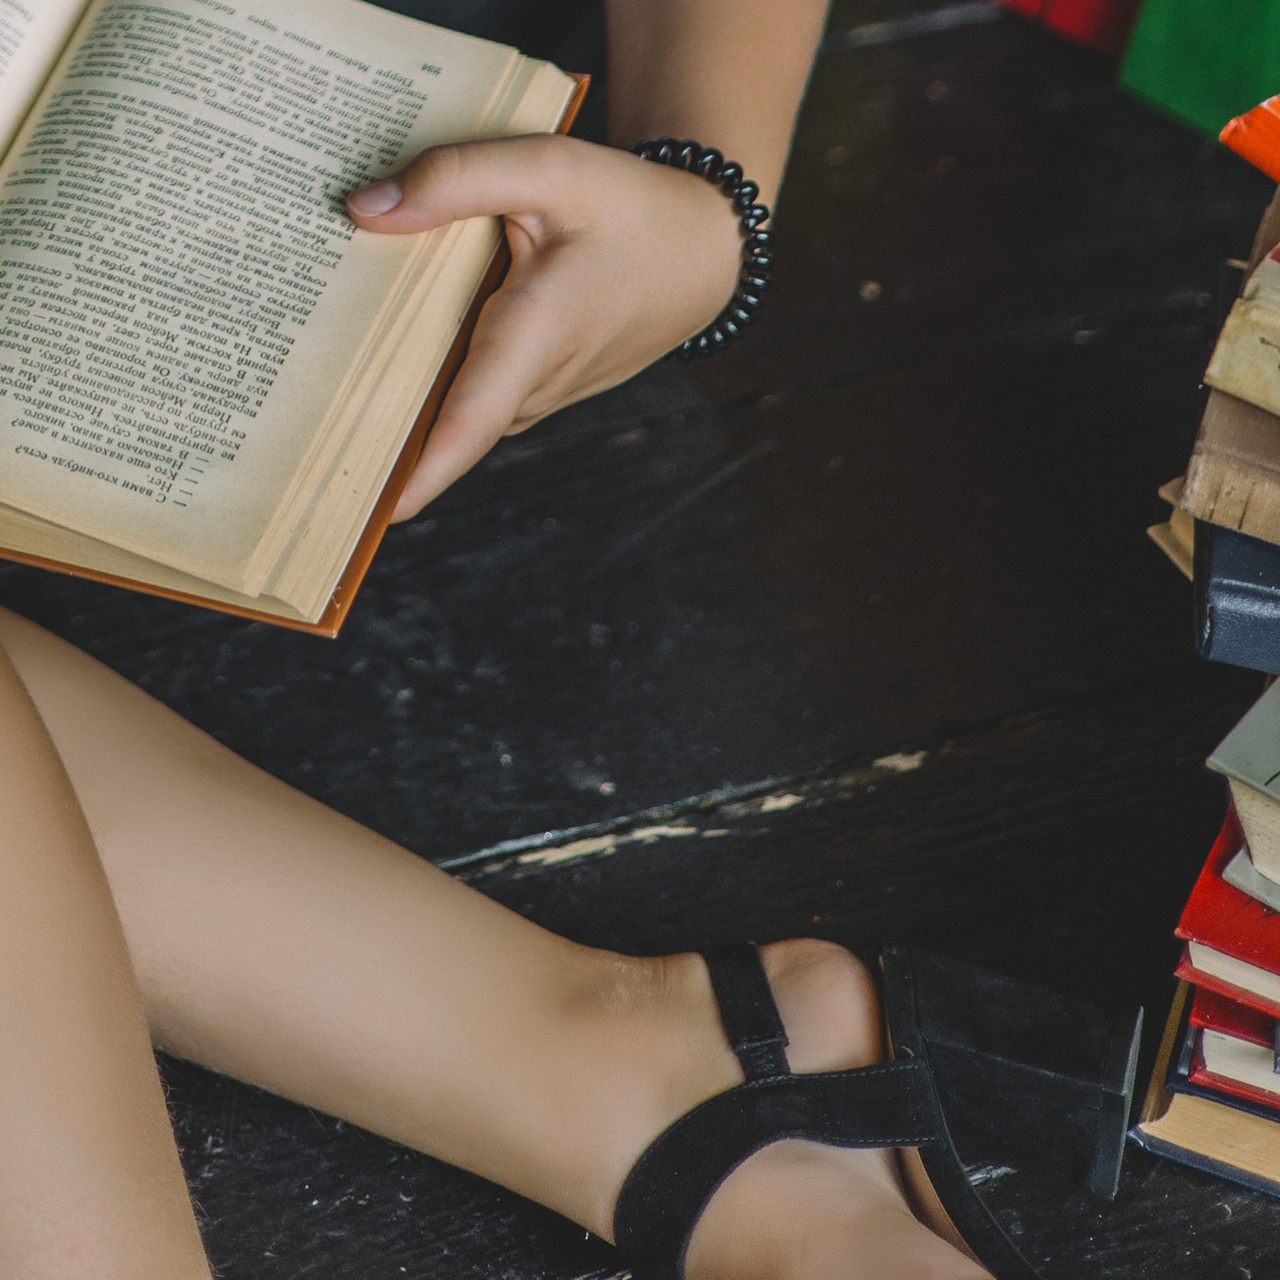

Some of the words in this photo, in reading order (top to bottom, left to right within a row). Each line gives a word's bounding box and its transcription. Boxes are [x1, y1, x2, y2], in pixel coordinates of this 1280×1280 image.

[27, 285, 80, 306] комнату
[73, 274, 125, 297] помазок
[6, 305, 32, 317] она
[38, 301, 88, 321] постели
[80, 300, 130, 323] пересек
[136, 294, 183, 319] бритья
[144, 309, 170, 325] над
[46, 315, 101, 338] комнаты
[89, 317, 108, 328] на
[182, 310, 208, 325] для
[208, 319, 243, 337] крем
[64, 333, 81, 344] ее
[129, 319, 179, 343] Мейсон
[177, 322, 229, 345] полочке
[28, 333, 83, 359] обратно
[82, 337, 149, 367] торопливо
[103, 332, 143, 352] конце
[143, 334, 181, 354] горел
[229, 341, 253, 356] На
[83, 350, 148, 379] портсигар
[143, 347, 191, 369] заднем
[181, 349, 233, 372] спальне
[233, 353, 281, 378] черний
[85, 365, 136, 388] повесил
[149, 363, 172, 378] Он
[204, 368, 243, 388] дверь
[36, 387, 54, 398] не
[149, 373, 189, 393] сунул
[244, 382, 270, 398] нул
[54, 393, 104, 417] Никого
[137, 384, 188, 407] Мейсон
[9, 391, 86, 423] оставайтесь
[119, 402, 137, 414] не
[189, 399, 234, 423] Перри
[87, 416, 133, 438] случае
[183, 410, 229, 433] группу
[134, 434, 174, 453] таком
[169, 419, 243, 453] кто-нибудь
[229, 428, 248, 440] ем
[113, 440, 185, 471] Насколько
[218, 450, 236, 462] не
[150, 465, 179, 482] Кто
